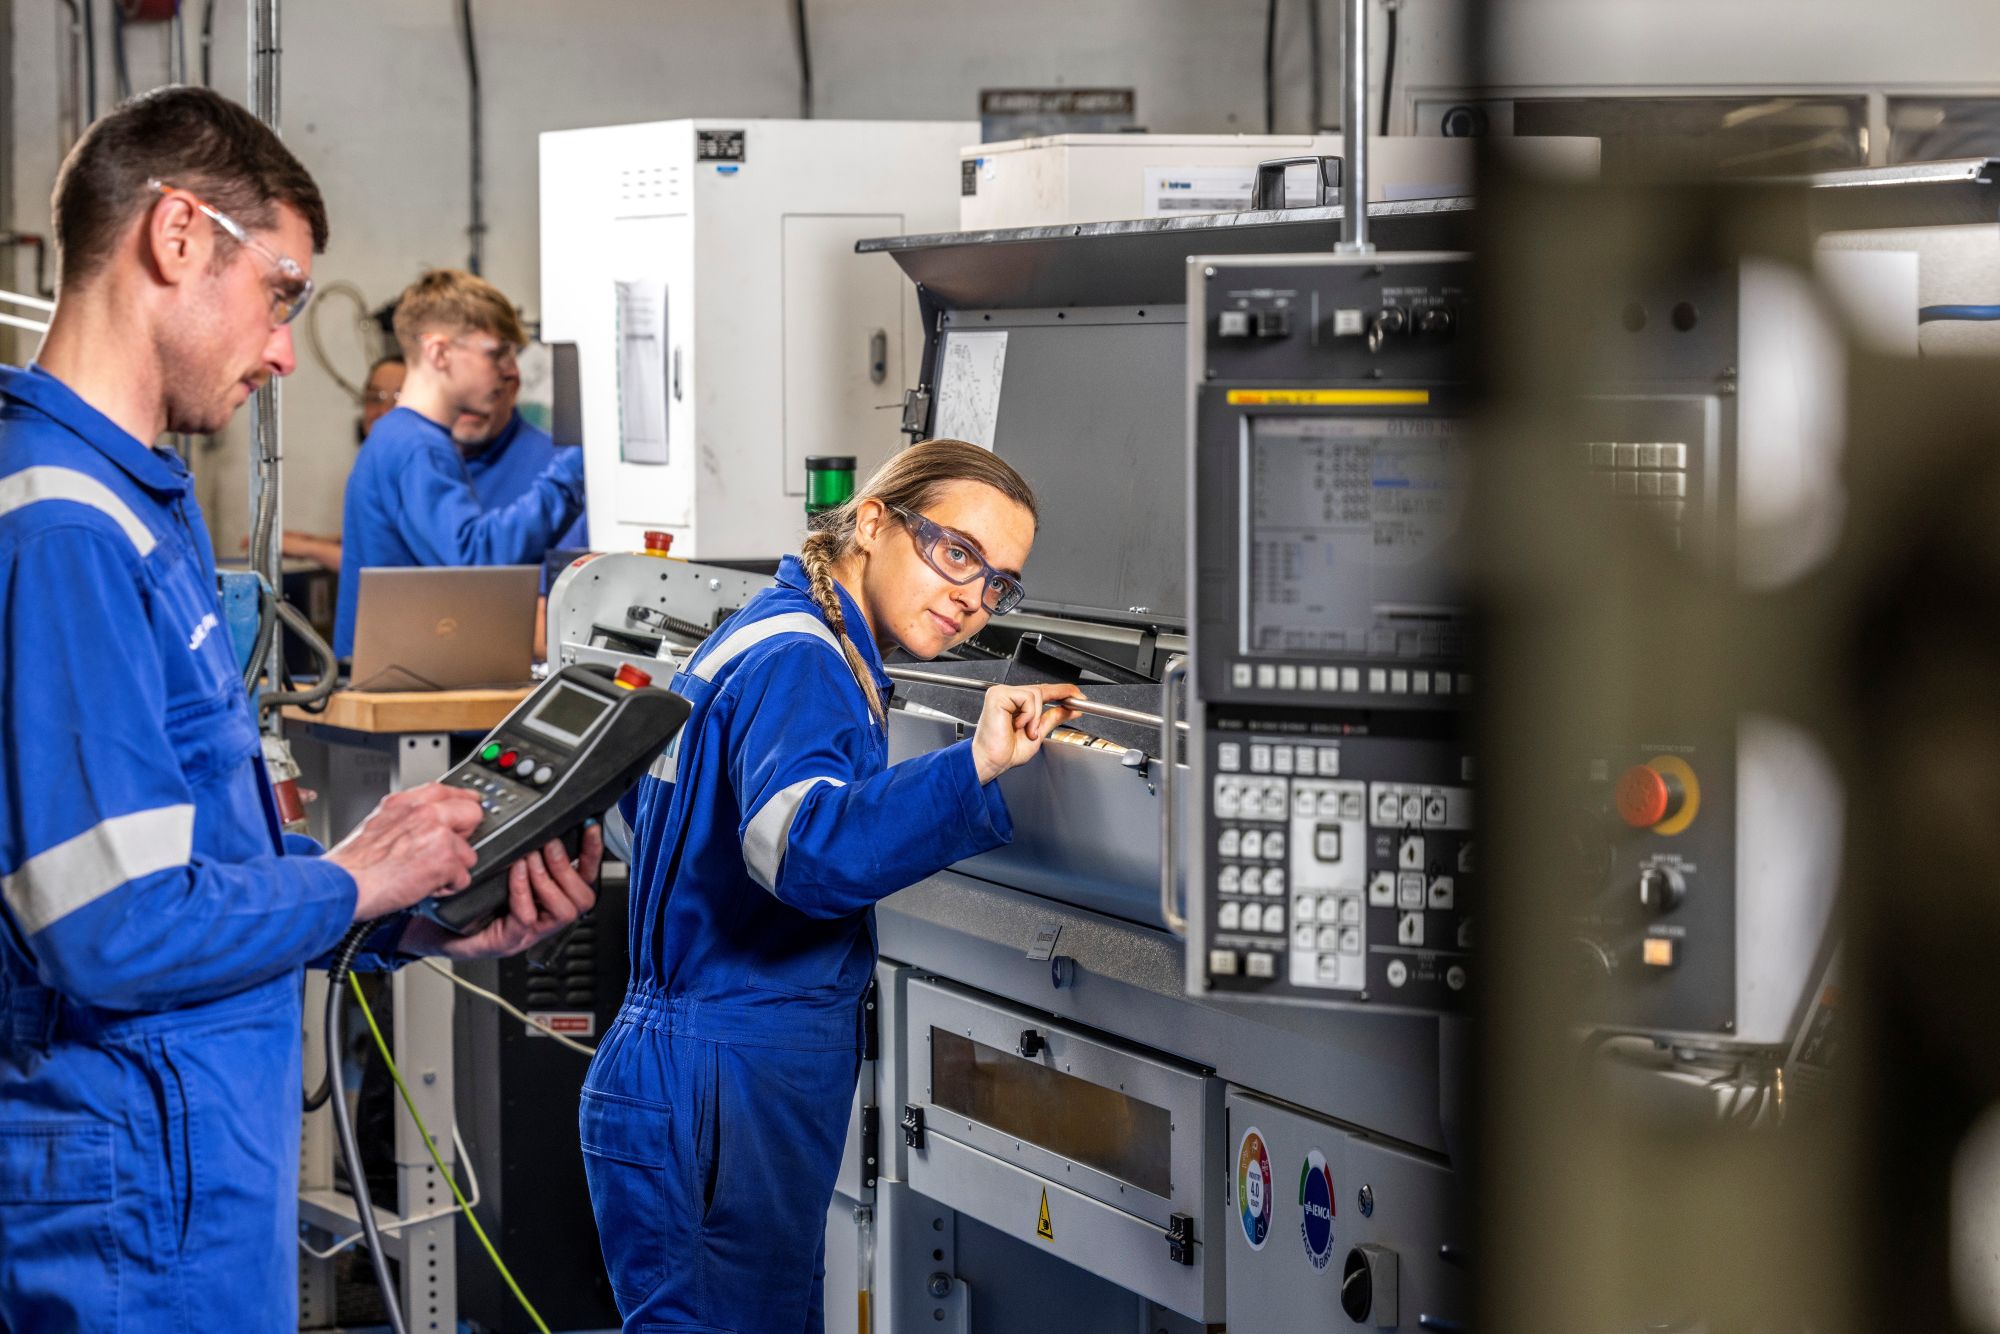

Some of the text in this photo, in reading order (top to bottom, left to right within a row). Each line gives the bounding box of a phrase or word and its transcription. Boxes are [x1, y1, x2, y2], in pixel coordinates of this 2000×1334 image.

[1250, 1181, 1260, 1199] 4.0
[1312, 1204, 1330, 1220] IEMCA
[1300, 1222, 1335, 1269] MADE IN EUROPE
